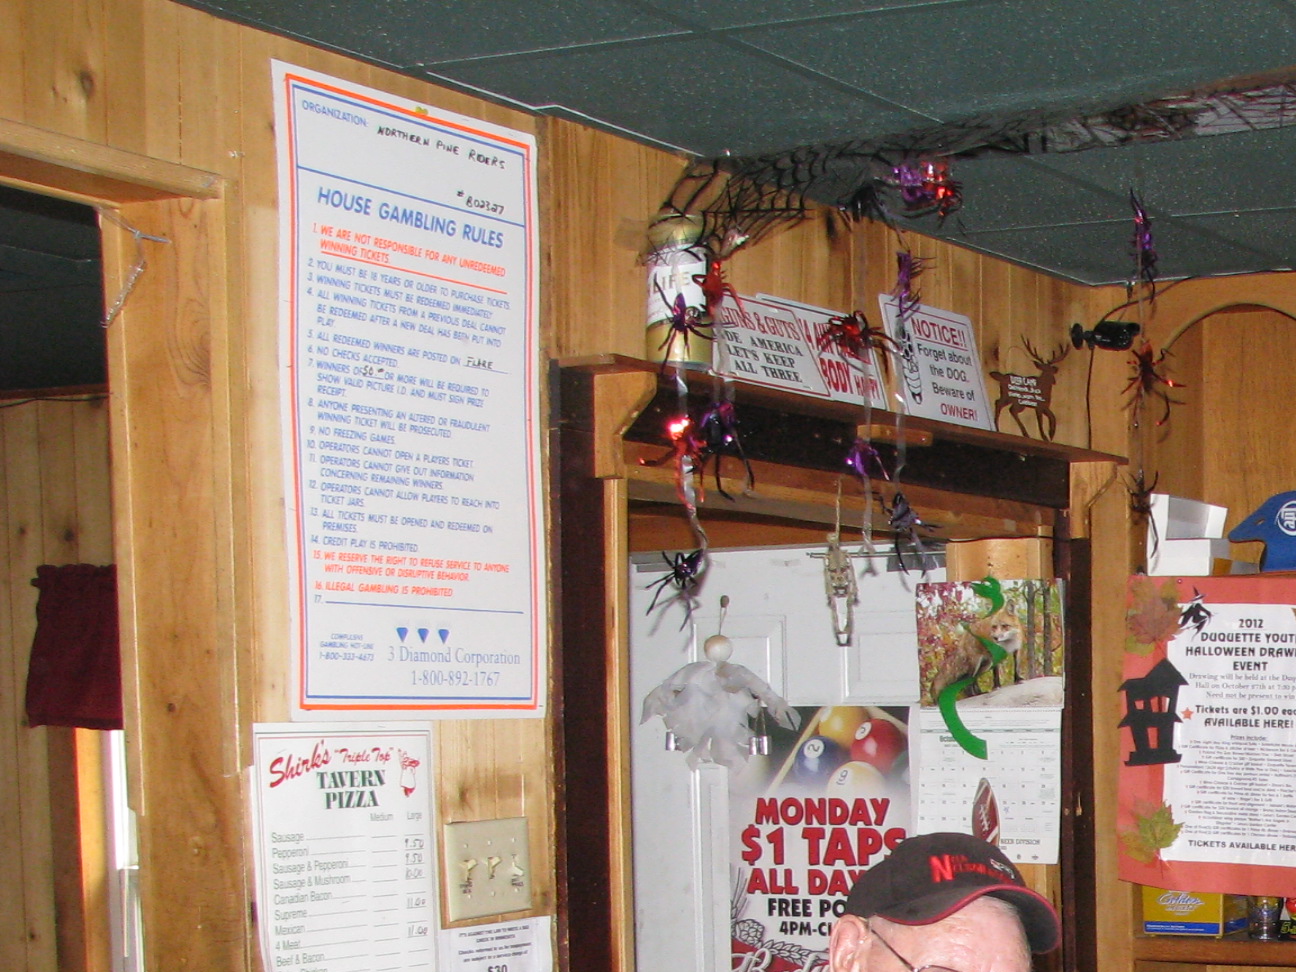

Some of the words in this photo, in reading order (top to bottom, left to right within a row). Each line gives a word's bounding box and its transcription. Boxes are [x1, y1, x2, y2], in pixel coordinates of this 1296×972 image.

[302, 100, 368, 127] ORGANIZATION:
[377, 126, 430, 146] NORTHERN
[436, 140, 460, 156] PINE
[468, 149, 505, 169] RIDERS
[317, 187, 372, 216] HOUSE
[379, 202, 457, 237] GAMBLING
[462, 224, 504, 249] RULES
[320, 239, 358, 256] WINNING
[320, 225, 334, 237] WE
[336, 229, 351, 241] ARE
[354, 232, 371, 245] NOT
[373, 237, 422, 257] RESPONSIBLE
[425, 249, 440, 262] FOR
[442, 254, 457, 265] ANY
[459, 258, 506, 277] UNREDEEMED
[317, 260, 333, 271] YOU
[335, 265, 356, 276] MUST
[358, 269, 368, 278] BE
[381, 274, 401, 286] YEARS
[404, 279, 414, 288] OR
[416, 282, 437, 293] OLDER
[720, 307, 753, 331] GUNS
[754, 313, 766, 333] &
[766, 317, 801, 341] GUTS
[911, 318, 966, 348] NOTICE!!
[332, 348, 361, 361] CHECKS
[333, 334, 371, 349] REDEEMED
[373, 341, 405, 355] WINNERS
[422, 350, 448, 363] POSTED
[727, 344, 760, 361] LET'S
[765, 352, 796, 369] KEEP
[751, 337, 803, 357] AMERICA
[916, 343, 946, 362] Forget
[948, 351, 973, 367] about
[734, 359, 758, 375] ALL
[761, 365, 802, 383] THREE
[930, 364, 944, 378] the
[932, 382, 965, 400] Beware
[966, 389, 975, 401] of
[941, 403, 978, 422] OWNER!
[324, 551, 336, 561] WE
[338, 552, 368, 563] RESERVE
[371, 554, 385, 564] THE
[386, 556, 407, 566] RIGHT
[420, 558, 444, 569] REFUSE
[446, 560, 471, 570] SERVICE
[484, 563, 510, 573] ANYONE
[324, 564, 343, 573] WITH
[346, 565, 383, 576] OFFENSIVE
[325, 581, 355, 592] ILLEGAL
[358, 583, 399, 594] GAMBLING
[1239, 619, 1264, 628] 2012
[1201, 632, 1261, 643] DUQUETTE
[387, 646, 396, 662] 3
[399, 646, 452, 663] Diamond
[454, 648, 521, 668] Corporation
[1185, 646, 1256, 657] HALLOWEEN
[1233, 661, 1268, 671] EVENT
[411, 670, 501, 686] 1-800-892-1767
[1195, 704, 1229, 714] Tickets
[1232, 706, 1248, 714] are
[1251, 706, 1279, 716] $1.00
[1204, 717, 1260, 728] AVAILABLE
[1263, 719, 1294, 729] HERE!
[269, 739, 331, 788] Shirk's
[316, 770, 386, 789] TAVERN
[325, 790, 380, 809] PIZZA
[755, 797, 890, 826] MONDAY
[271, 832, 305, 844] Sausage
[741, 824, 785, 865] $1
[1188, 839, 1226, 849] TICKETS
[1229, 841, 1277, 851] AVAILABLE
[272, 848, 309, 860] Pepperoni
[273, 863, 305, 875] Sausage
[314, 860, 349, 872] Pepperoni
[273, 878, 306, 890] Sausage
[314, 875, 350, 886] Mushroom
[747, 868, 800, 896] ALL
[274, 893, 308, 905] Canadian
[311, 891, 333, 902] Bacon
[768, 898, 812, 917] FREE
[274, 909, 308, 921] Supreme
[275, 925, 305, 935] Mexican
[276, 955, 295, 967] Beef
[302, 953, 325, 965] Bacon
